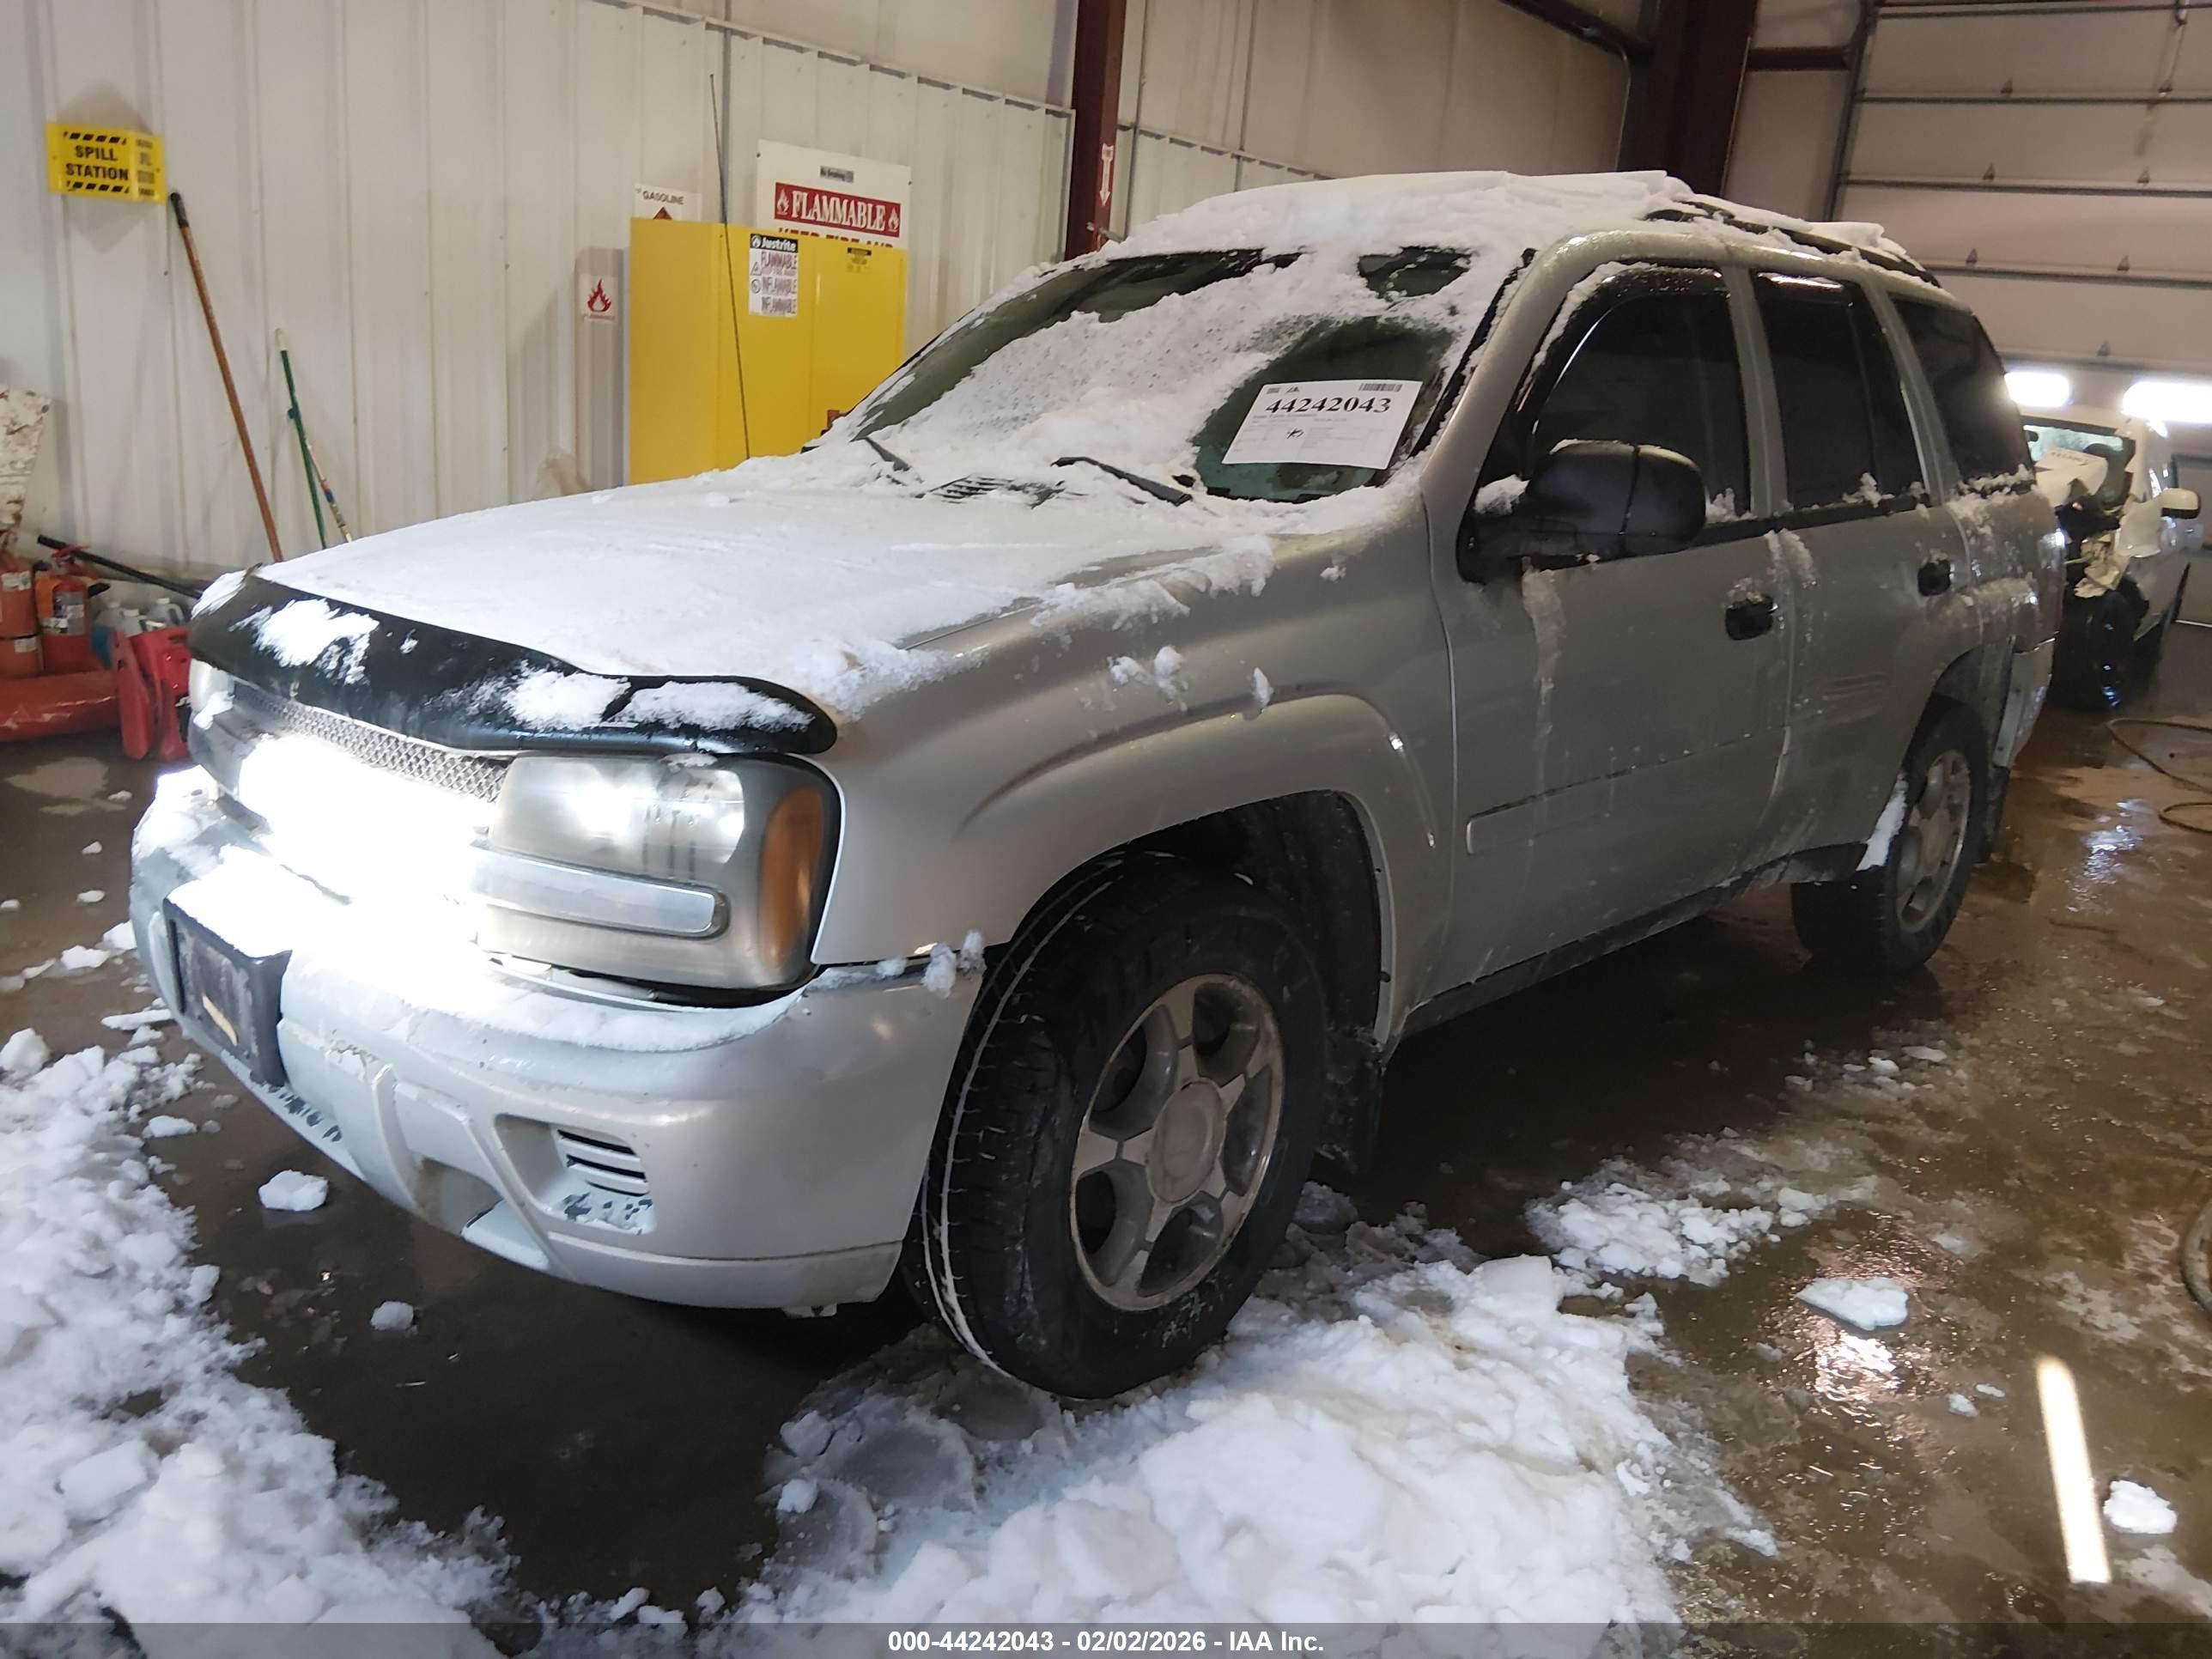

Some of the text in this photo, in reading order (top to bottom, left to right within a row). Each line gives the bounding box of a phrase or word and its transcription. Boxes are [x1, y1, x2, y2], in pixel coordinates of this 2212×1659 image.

[76, 145, 118, 161] SPILL
[66, 163, 129, 181] STATION
[791, 191, 886, 232] FLAMMABLE
[761, 237, 797, 252] Justrite
[1265, 397, 1391, 413] 44242043
